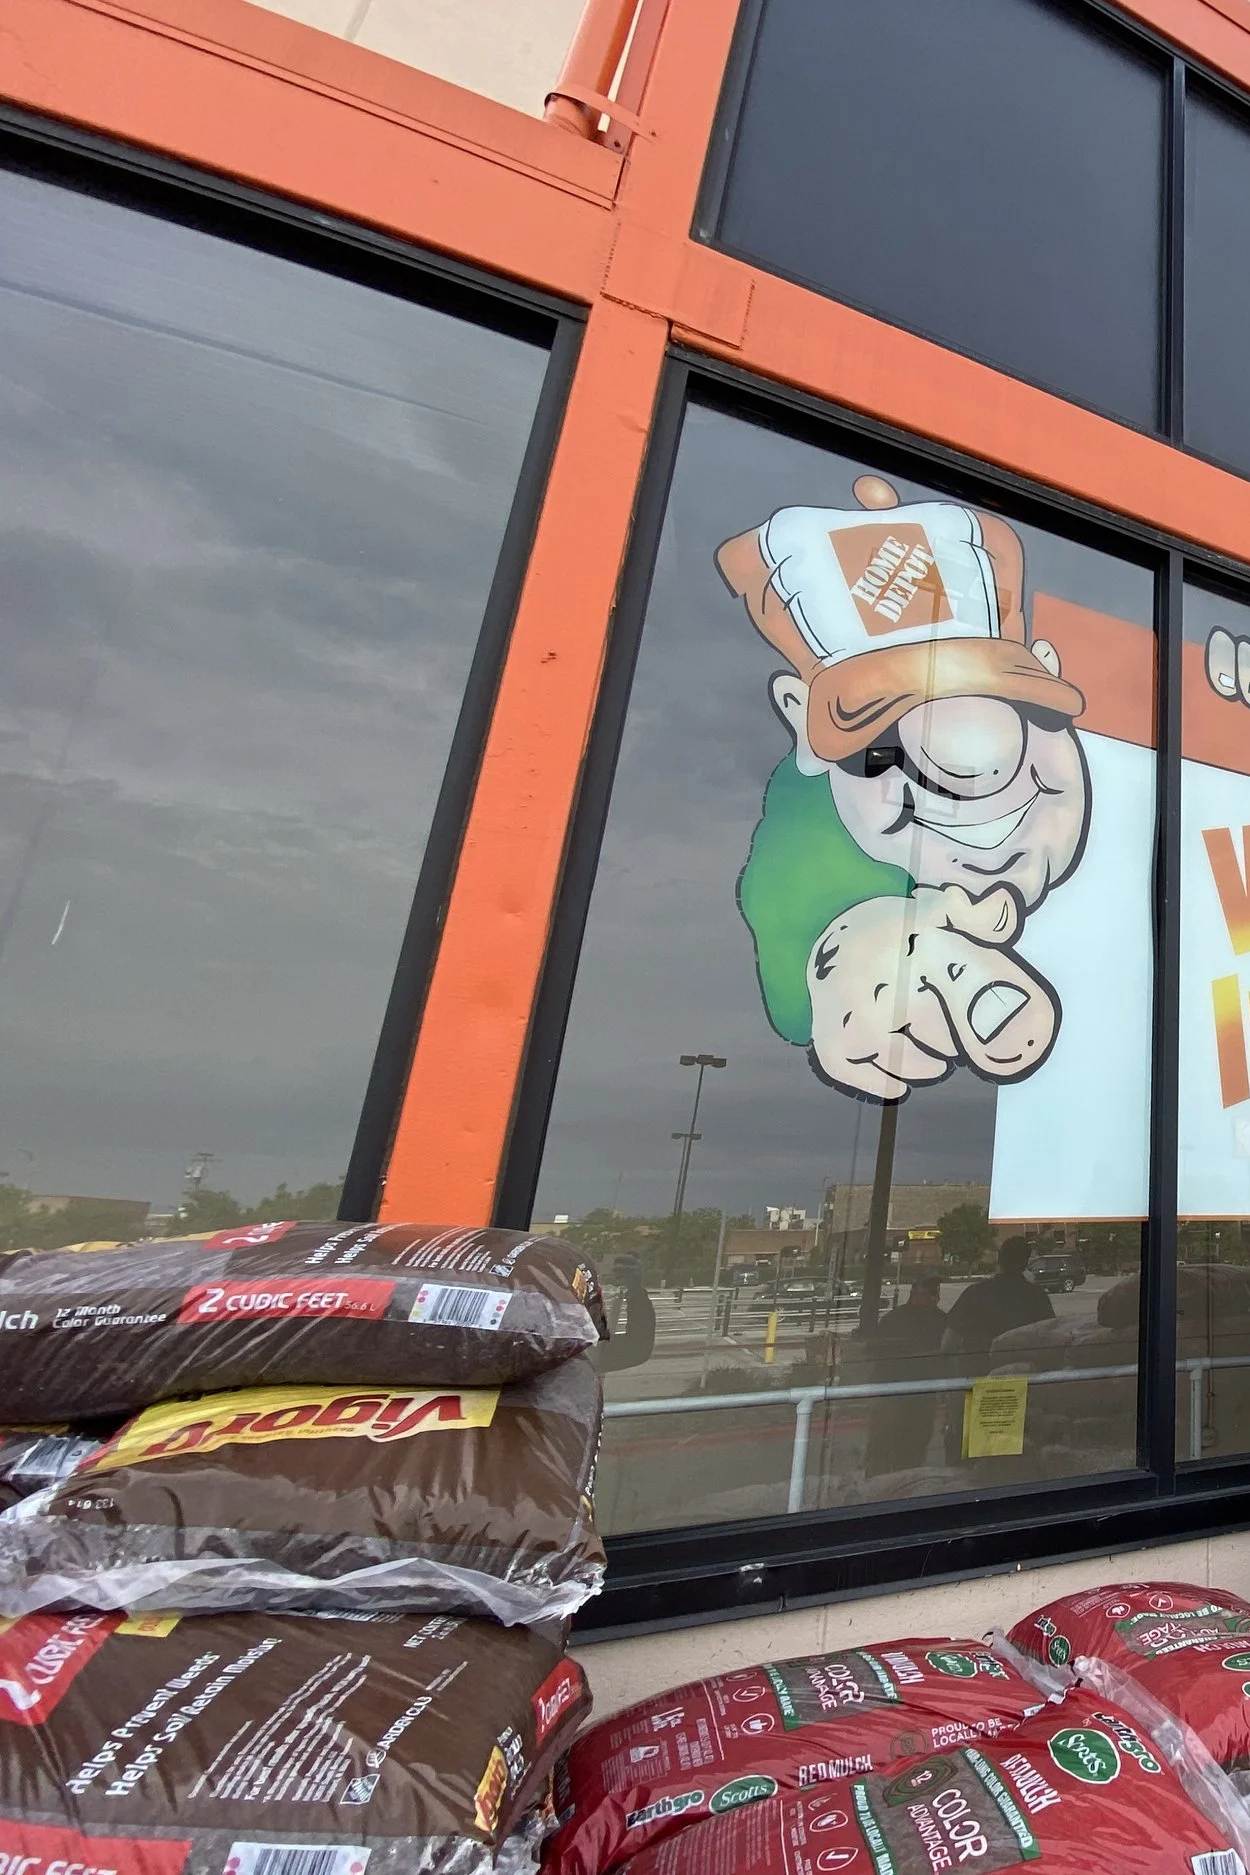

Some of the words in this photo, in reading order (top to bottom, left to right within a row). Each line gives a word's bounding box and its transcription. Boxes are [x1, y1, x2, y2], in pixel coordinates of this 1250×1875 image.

[850, 535, 910, 606] HOME
[873, 543, 935, 624] DEPOT
[0, 1310, 39, 1331] lch
[53, 1317, 91, 1329] Color
[94, 1313, 167, 1327] Guarantee
[57, 1307, 71, 1319] 12
[198, 1288, 225, 1314] 2
[226, 1291, 294, 1311] CUBIC
[296, 1291, 349, 1310] FEET
[105, 1743, 163, 1796] Helps
[180, 1676, 236, 1715] Retain
[628, 1791, 703, 1829] Earthgro
[719, 1783, 767, 1808] Scotts
[799, 1763, 827, 1786] RED
[828, 1754, 874, 1779] MULCH
[932, 1788, 988, 1862] COLOR
[907, 1804, 952, 1872] ADVANTAGE
